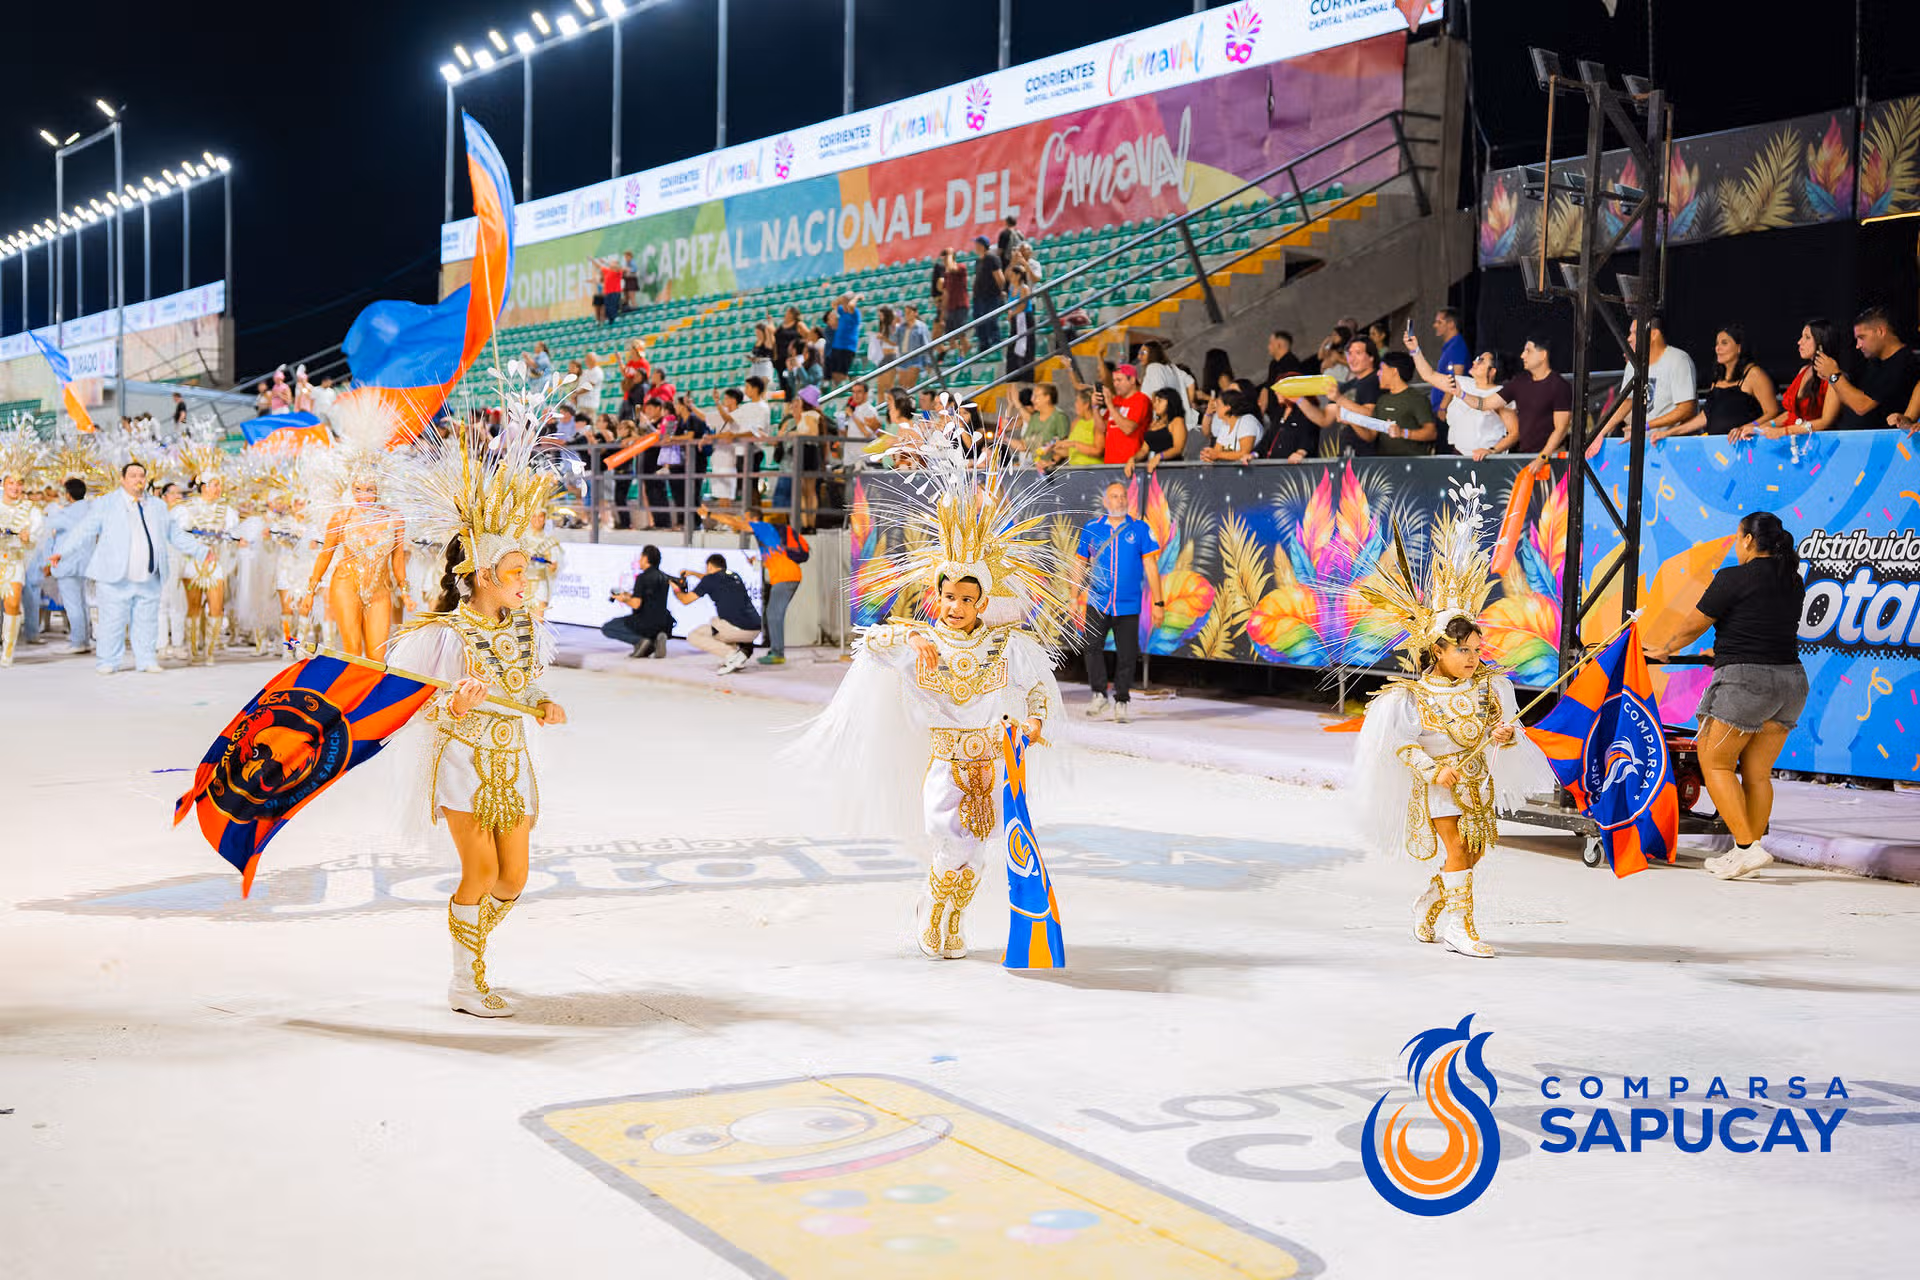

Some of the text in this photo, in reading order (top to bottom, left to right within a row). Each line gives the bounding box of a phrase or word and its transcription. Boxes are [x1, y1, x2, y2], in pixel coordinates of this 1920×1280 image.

[1024, 61, 1096, 93] CORRIENTES
[818, 124, 871, 149] CORRIENTES
[642, 227, 749, 284] CAPITAL
[760, 188, 932, 263] NACIONAL
[944, 168, 1021, 230] DEL
[1623, 702, 1658, 789] COMPARSA
